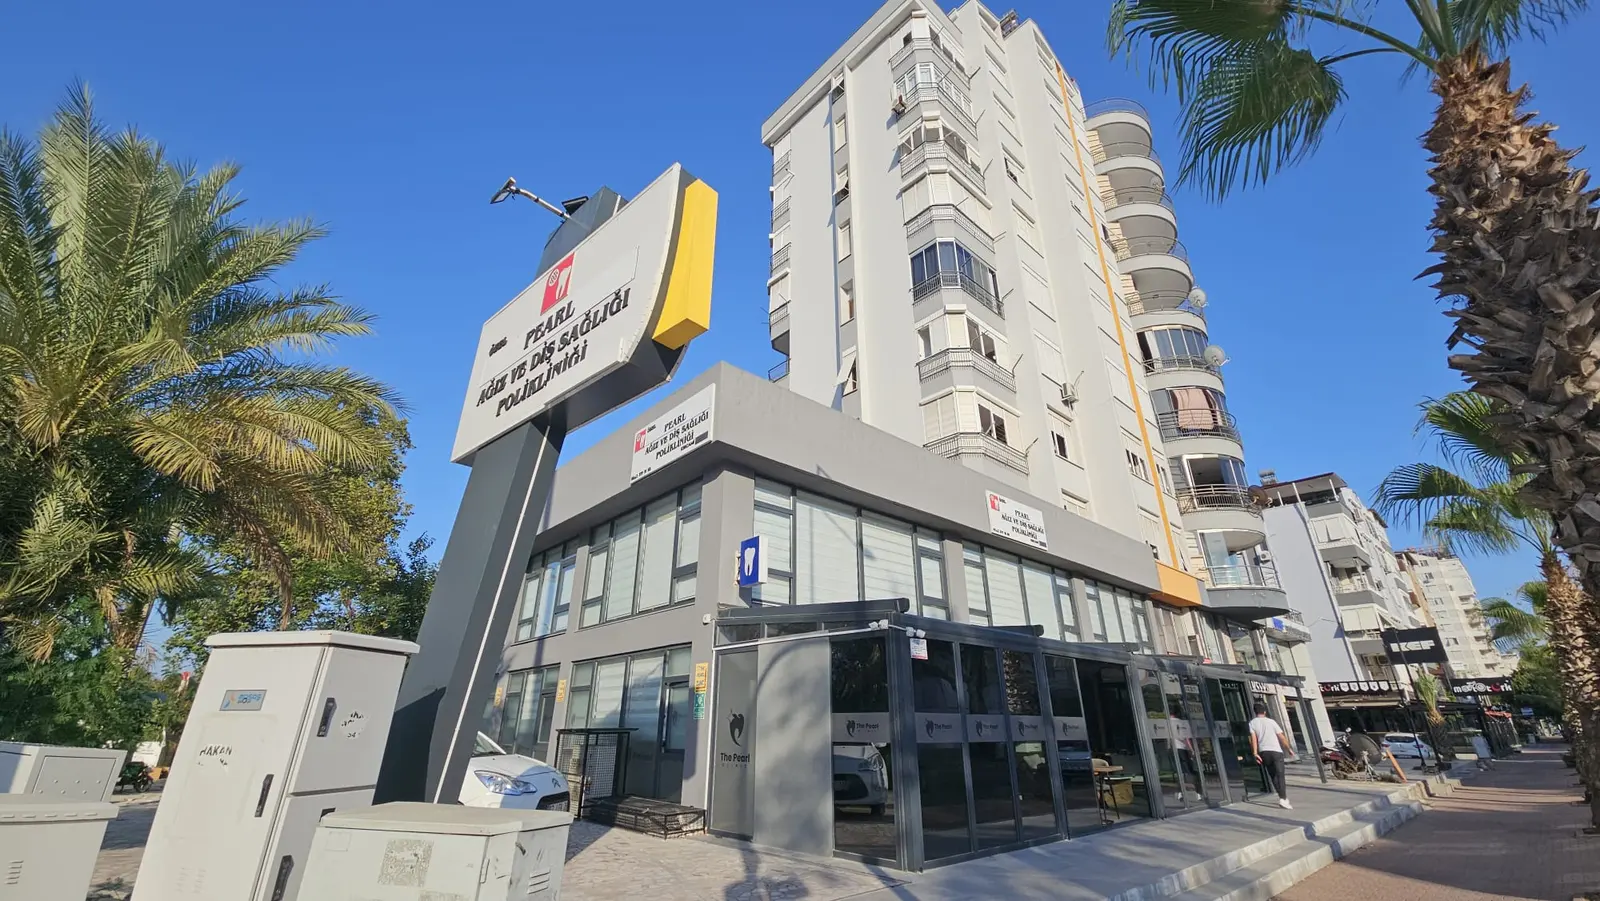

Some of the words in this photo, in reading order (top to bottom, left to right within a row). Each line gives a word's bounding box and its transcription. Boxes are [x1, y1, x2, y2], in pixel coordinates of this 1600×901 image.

[476, 377, 509, 407] AĞIZ
[510, 360, 528, 384] VE
[529, 341, 556, 372] DİŞ
[557, 287, 631, 352] SAĞLIĞI
[523, 300, 576, 350] PEARL
[496, 339, 588, 417] POLİKLİNİĞİ
[664, 413, 687, 432] PEARL
[720, 752, 732, 762] The
[733, 753, 750, 763] Pearl
